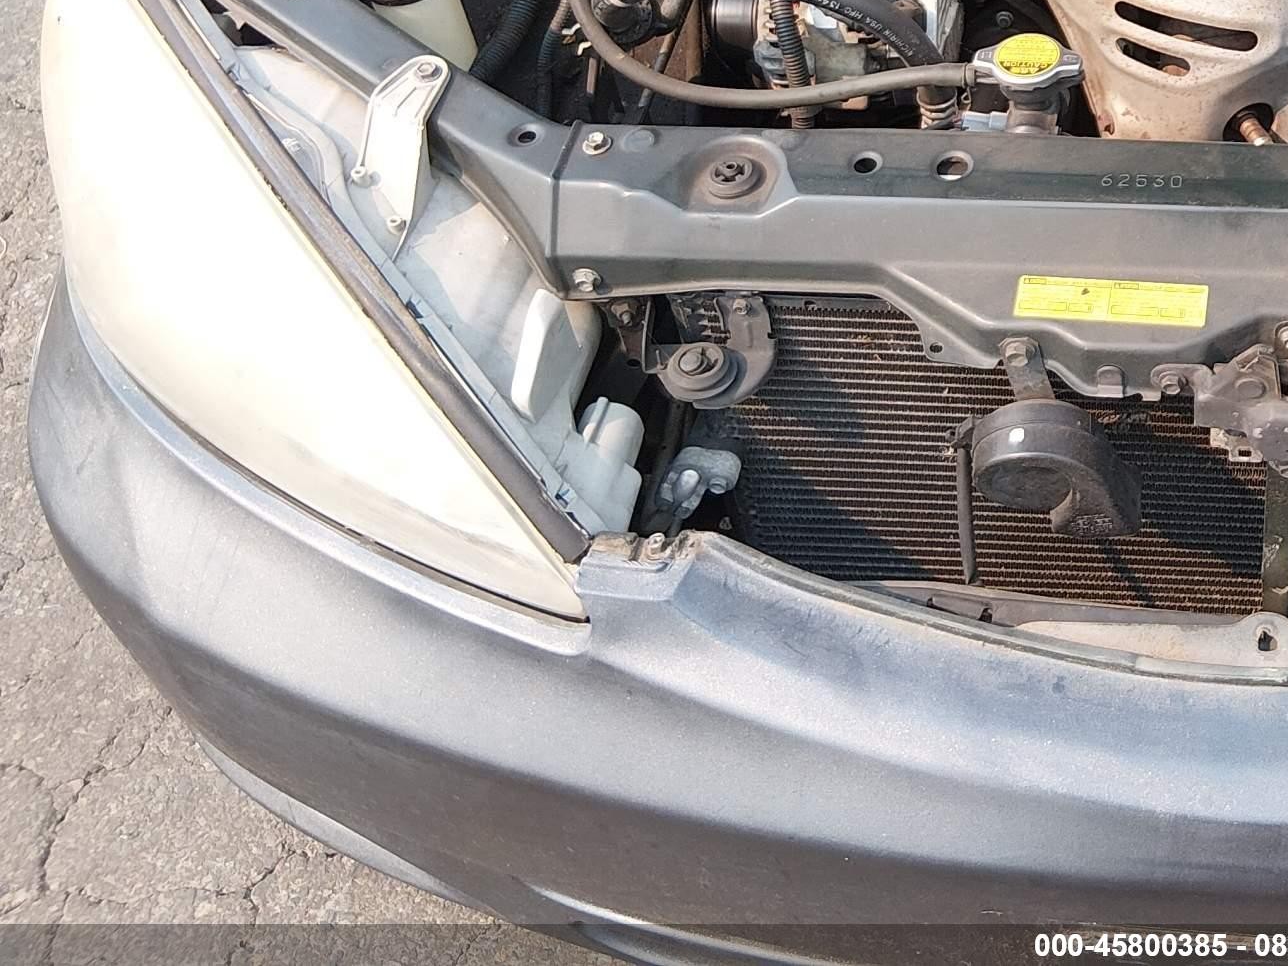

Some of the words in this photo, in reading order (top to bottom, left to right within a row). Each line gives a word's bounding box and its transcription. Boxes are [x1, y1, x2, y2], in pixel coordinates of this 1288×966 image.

[844, 6, 863, 20] HFC
[1003, 61, 1048, 69] CAUTION
[1101, 173, 1184, 188] 62530
